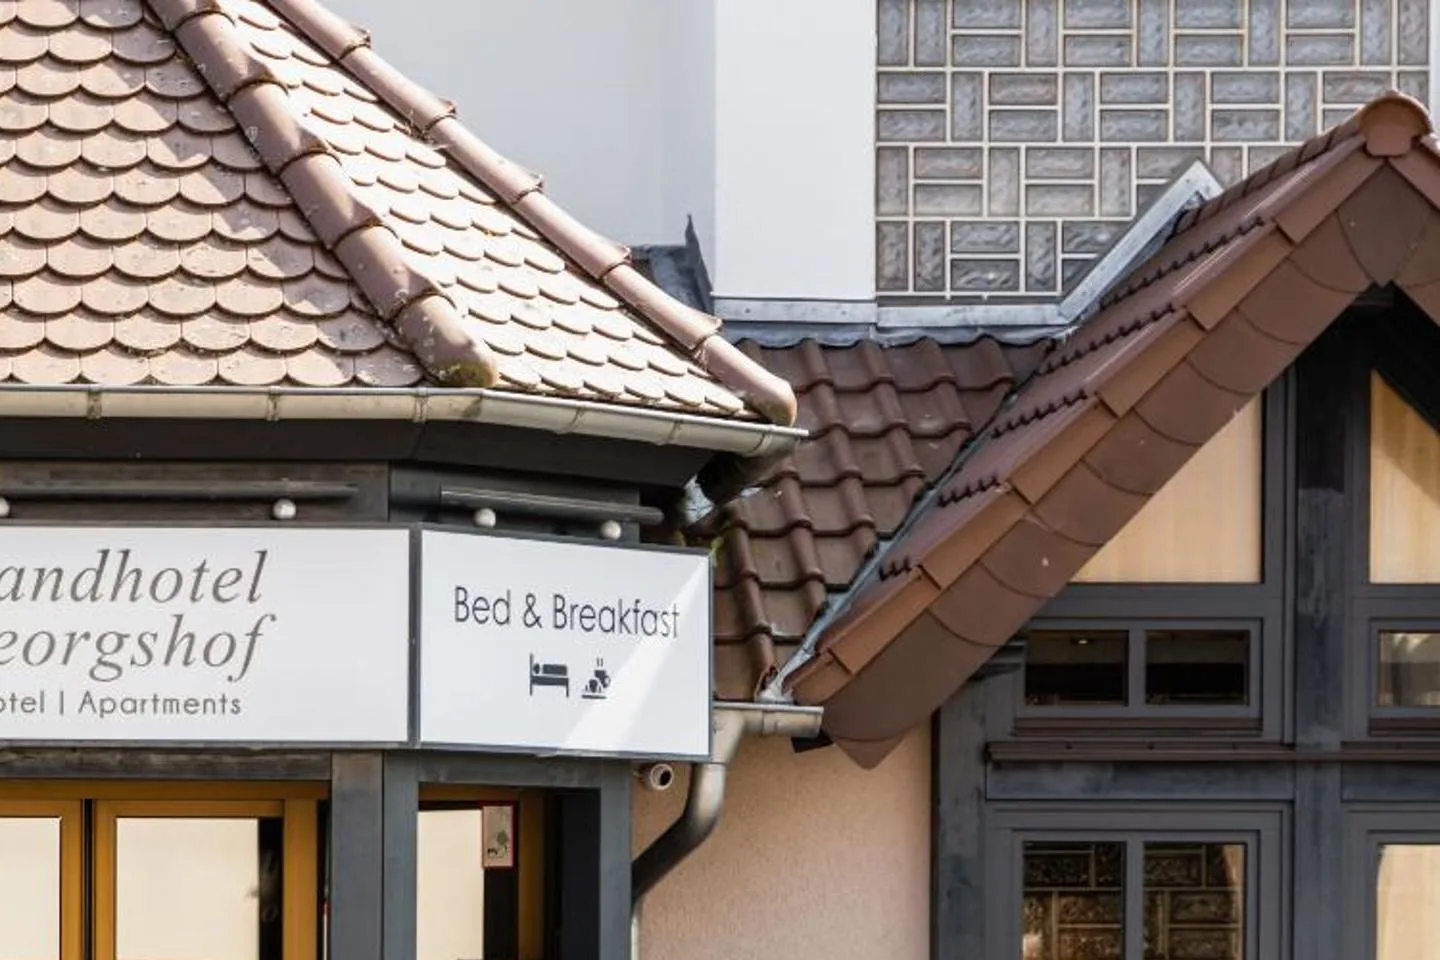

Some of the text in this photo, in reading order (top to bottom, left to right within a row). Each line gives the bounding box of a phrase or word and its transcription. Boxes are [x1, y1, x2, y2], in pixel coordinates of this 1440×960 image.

[454, 585, 681, 638] Bed & Breakfast
[77, 690, 242, 720] Apartments
